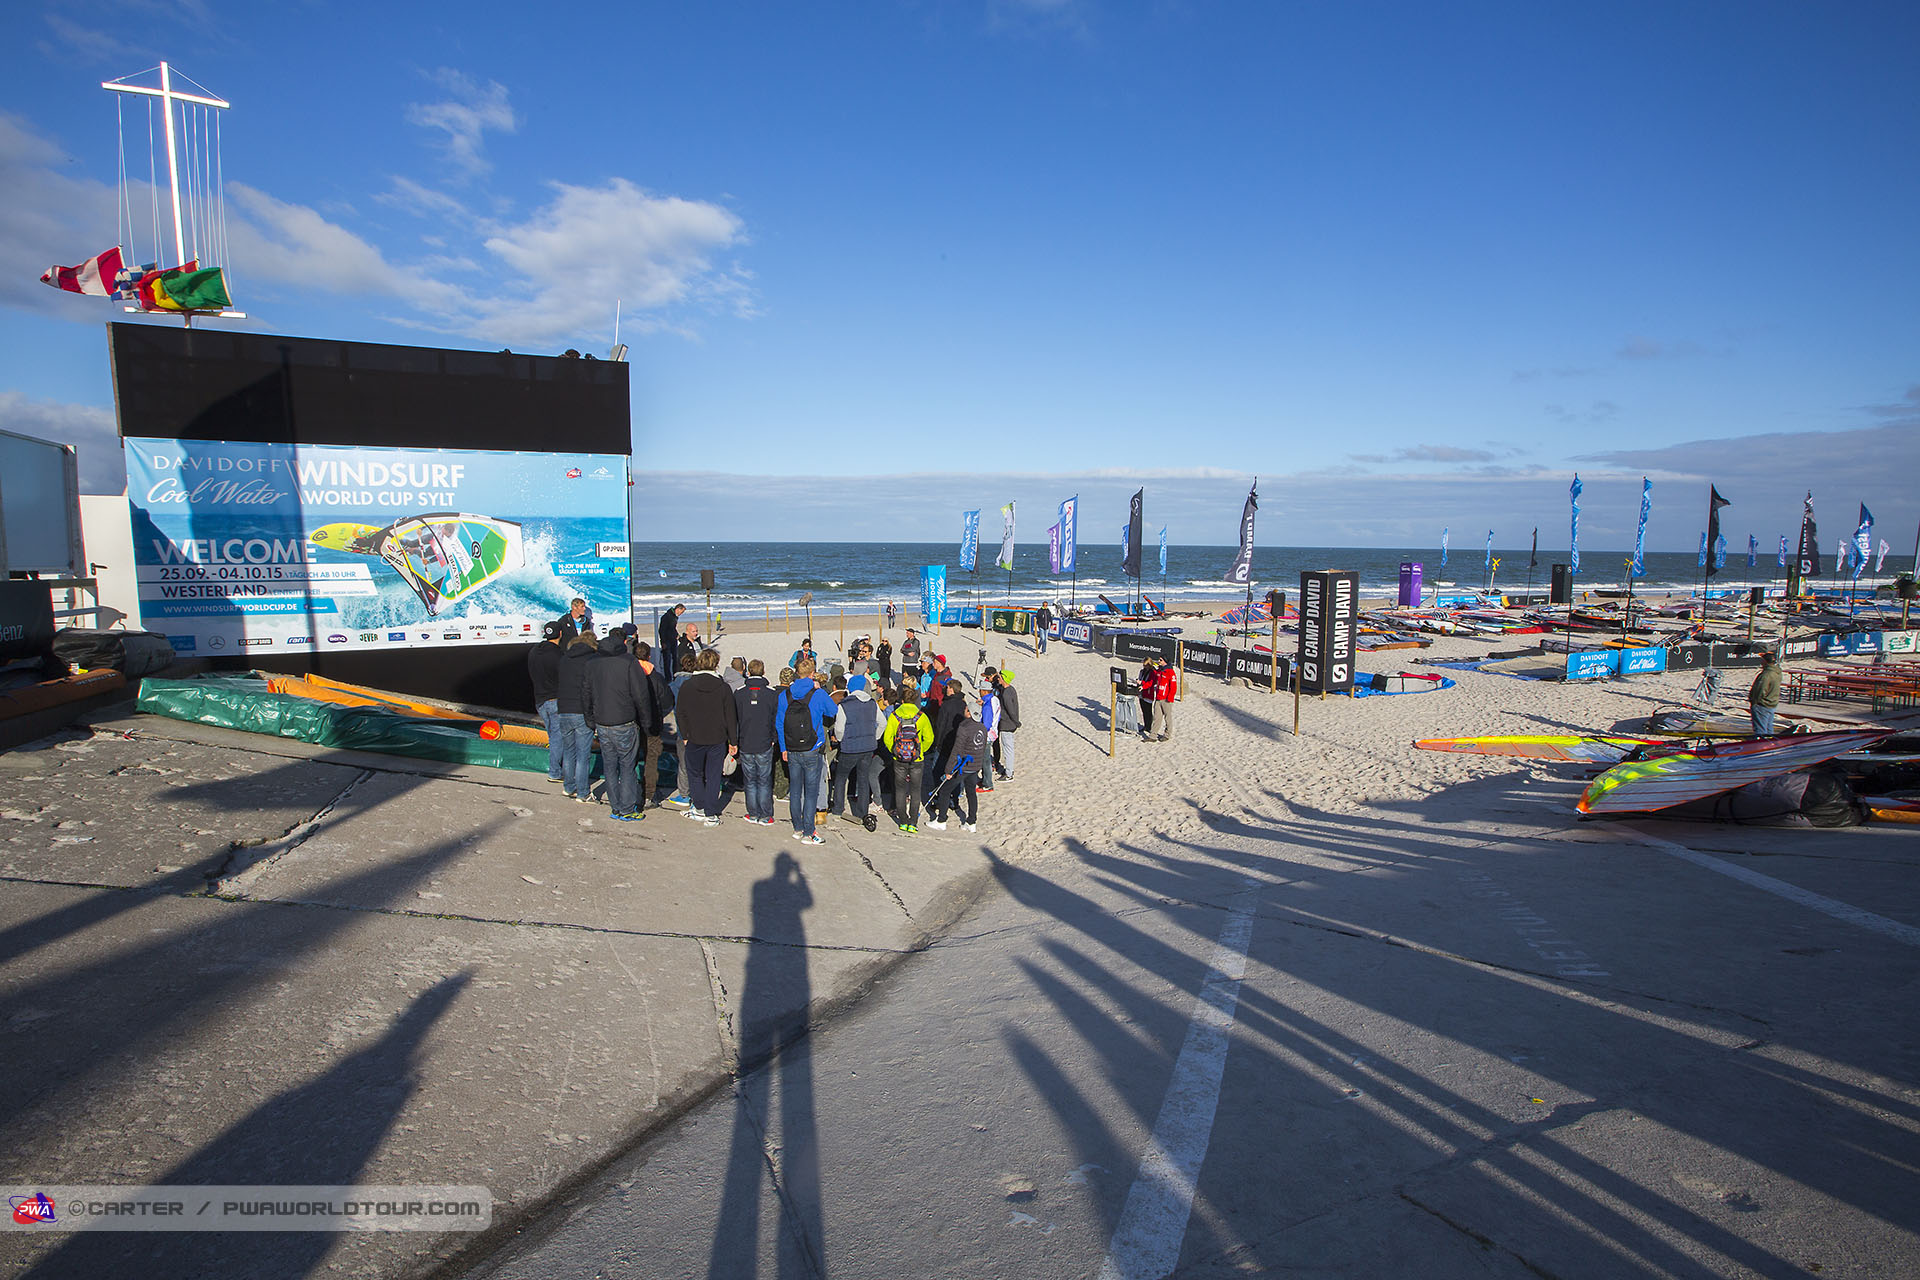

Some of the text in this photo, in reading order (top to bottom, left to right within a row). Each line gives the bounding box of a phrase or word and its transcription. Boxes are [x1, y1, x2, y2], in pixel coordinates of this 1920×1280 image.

[153, 455, 281, 473] DAVIDOFF
[300, 459, 465, 489] WINDSURF
[146, 477, 288, 505] Cool Water
[304, 490, 455, 507] WORLD CUP SYLT
[151, 538, 317, 564] WELCOME
[160, 584, 268, 598] WESTERLAND
[163, 602, 298, 614] WWW.WINDSURFWORLDCUP.DE
[1305, 579, 1321, 658] CAMP DAVID
[1333, 580, 1351, 659] CAMP DAVID
[359, 633, 378, 643] JEVER
[1066, 625, 1080, 638] ran
[1129, 642, 1161, 653] Mercedes-Benz
[1631, 649, 1657, 658] DAVIDOFF
[1191, 649, 1221, 666] CAMP DAVID
[1580, 653, 1609, 662] DAVIDOFF
[1246, 660, 1263, 674] CAMP
